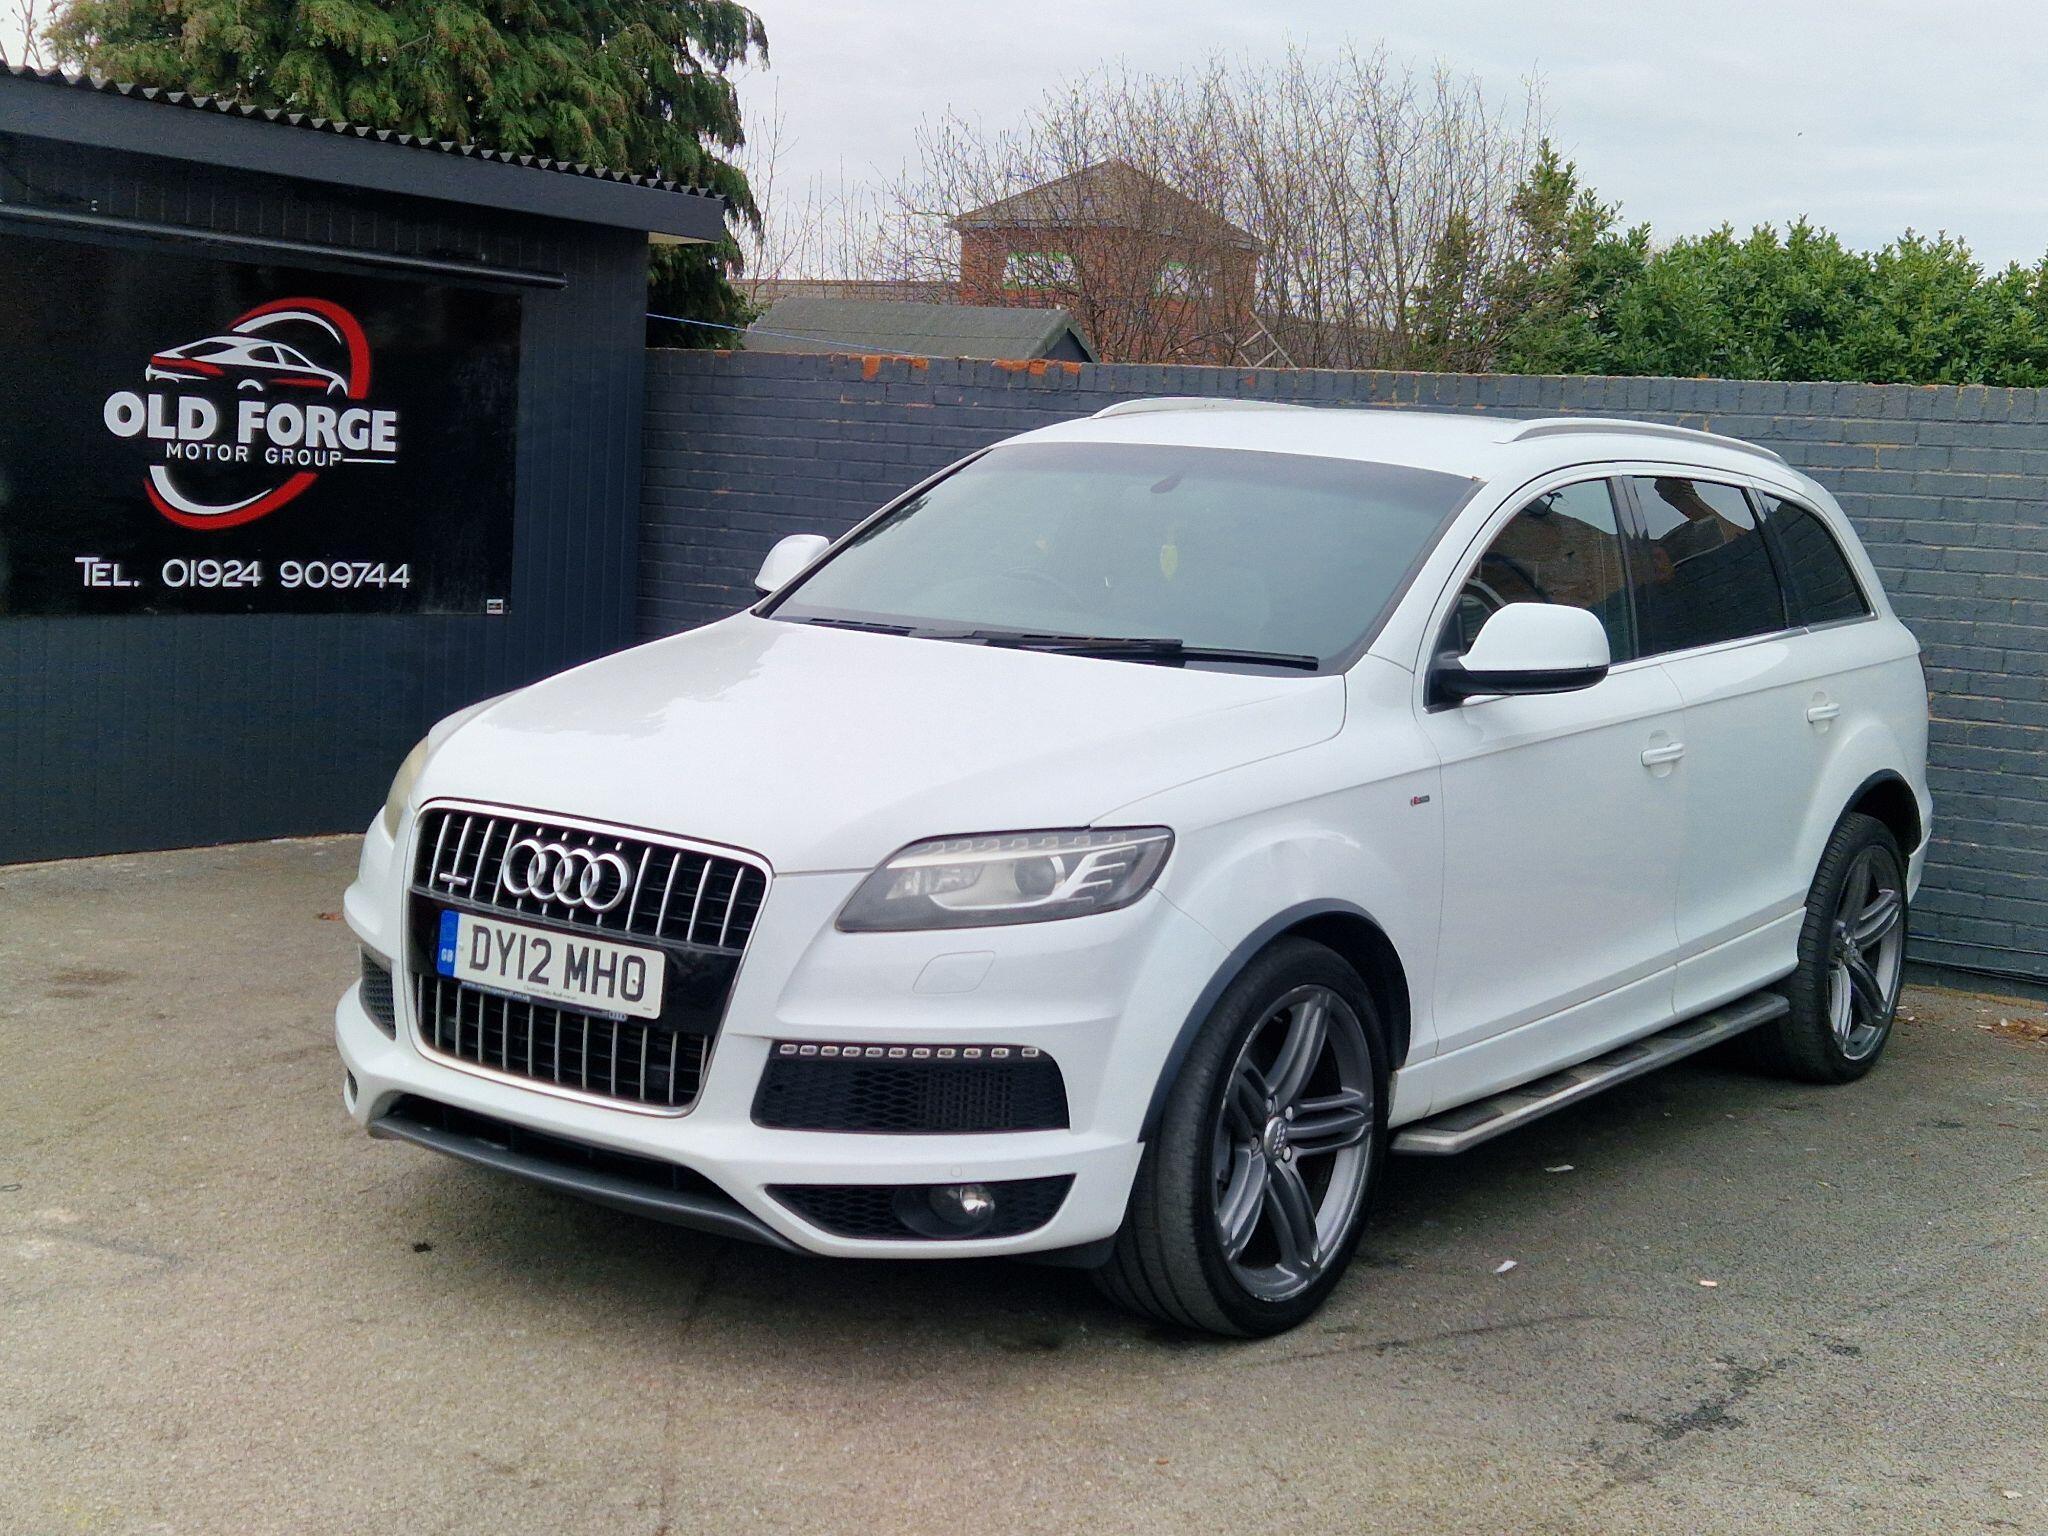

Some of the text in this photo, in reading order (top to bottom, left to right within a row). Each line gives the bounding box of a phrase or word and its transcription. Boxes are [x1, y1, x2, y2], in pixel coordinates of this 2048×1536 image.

[104, 391, 397, 452] OLD FORGE
[166, 442, 343, 467] MOTOR GROUP
[75, 556, 411, 589] TEL. 01924 909744
[469, 924, 647, 1002] DY12 MHO
